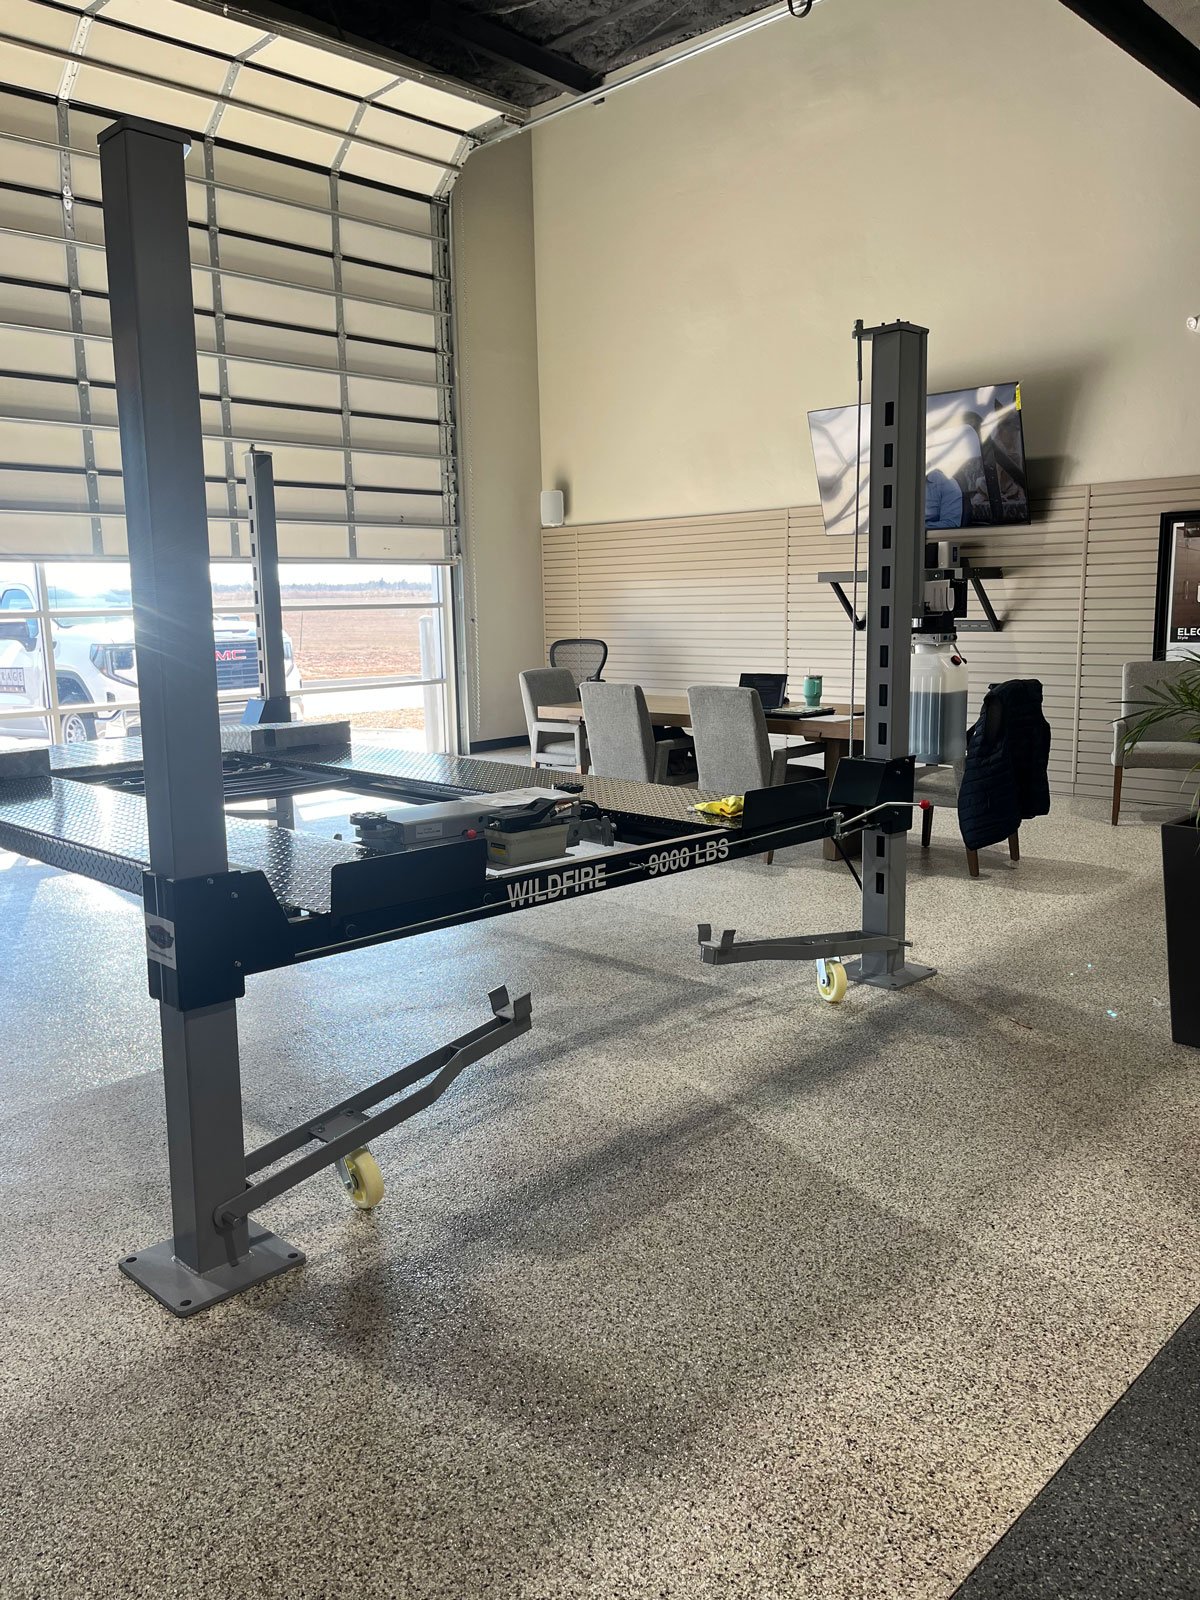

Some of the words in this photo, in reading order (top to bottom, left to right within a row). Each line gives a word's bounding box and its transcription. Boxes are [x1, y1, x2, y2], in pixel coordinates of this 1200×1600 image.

[215, 649, 247, 661] MC
[507, 863, 607, 908] WILDFIRE
[648, 847, 689, 876] 9000
[695, 838, 729, 865] LBS
